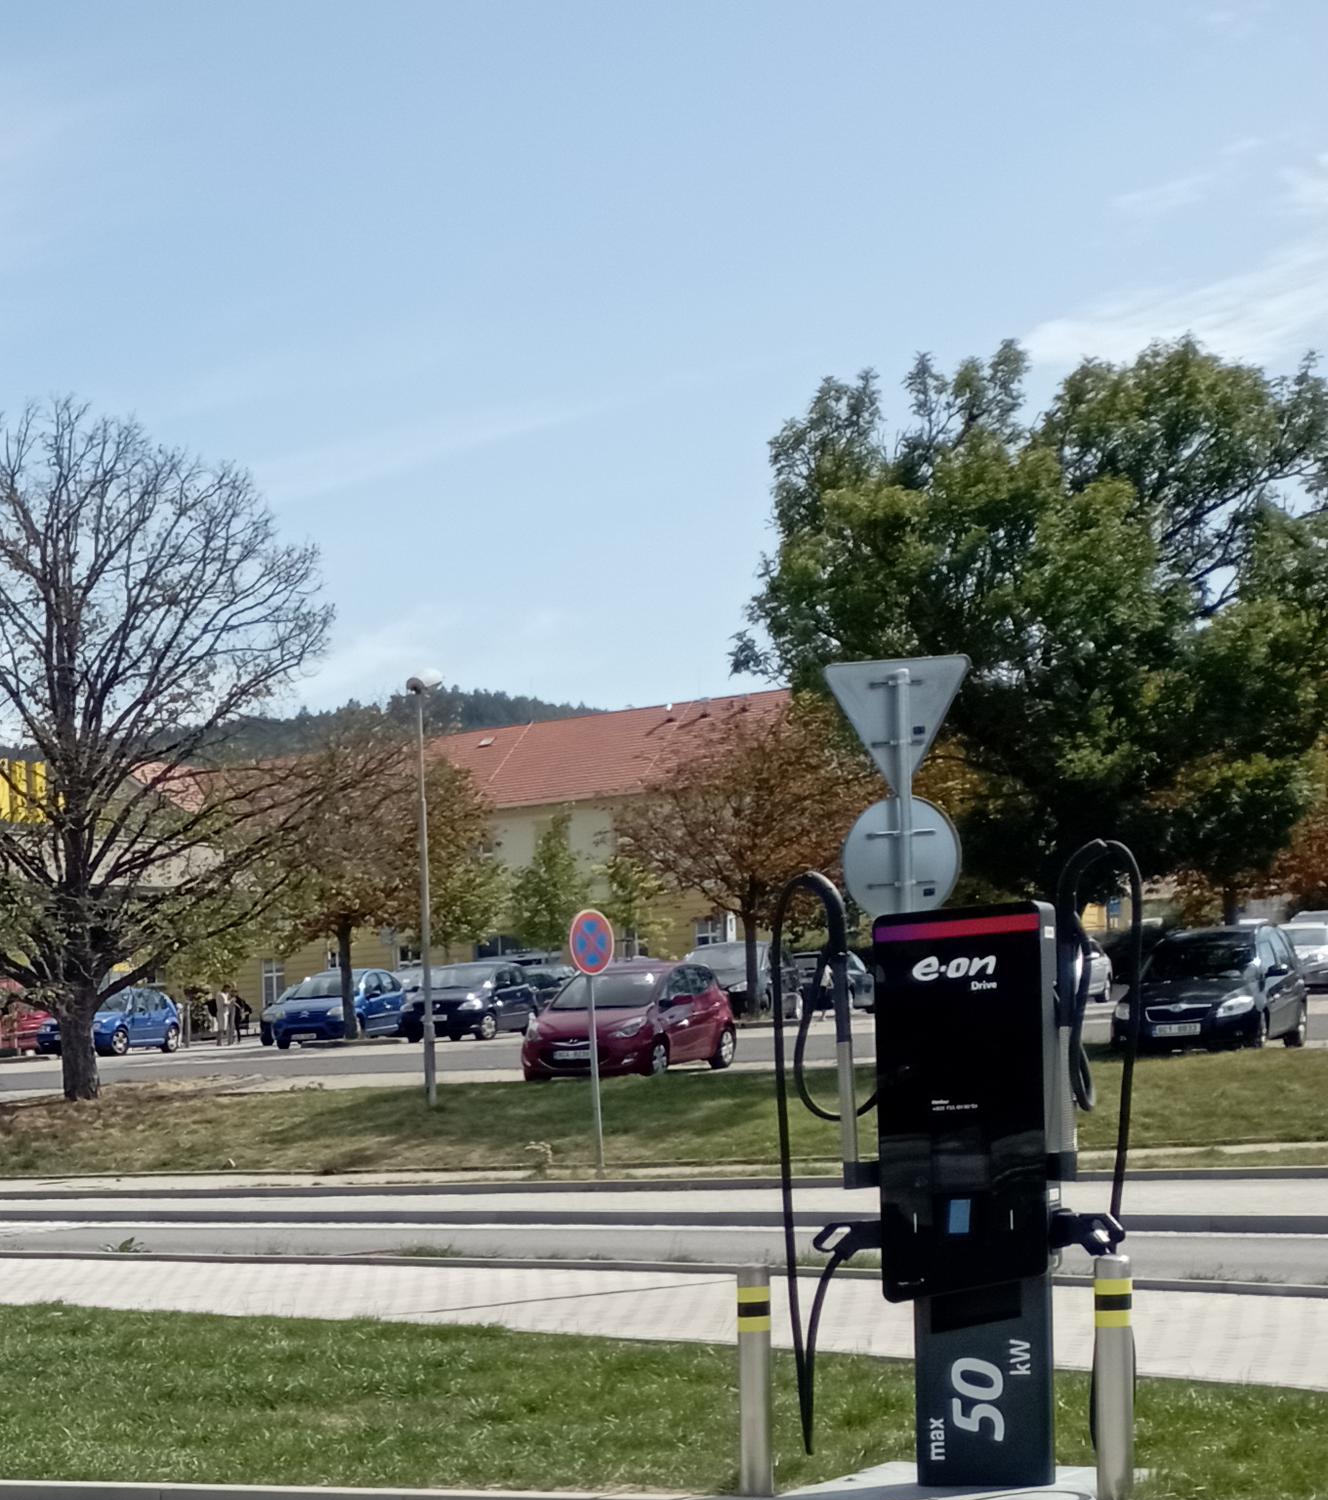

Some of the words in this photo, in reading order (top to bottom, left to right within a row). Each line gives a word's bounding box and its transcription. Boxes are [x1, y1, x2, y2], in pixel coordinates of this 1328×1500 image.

[970, 979, 998, 992] Drive
[1009, 1338, 1031, 1376] kW
[950, 1357, 1005, 1442] 50
[929, 1416, 946, 1461] max
